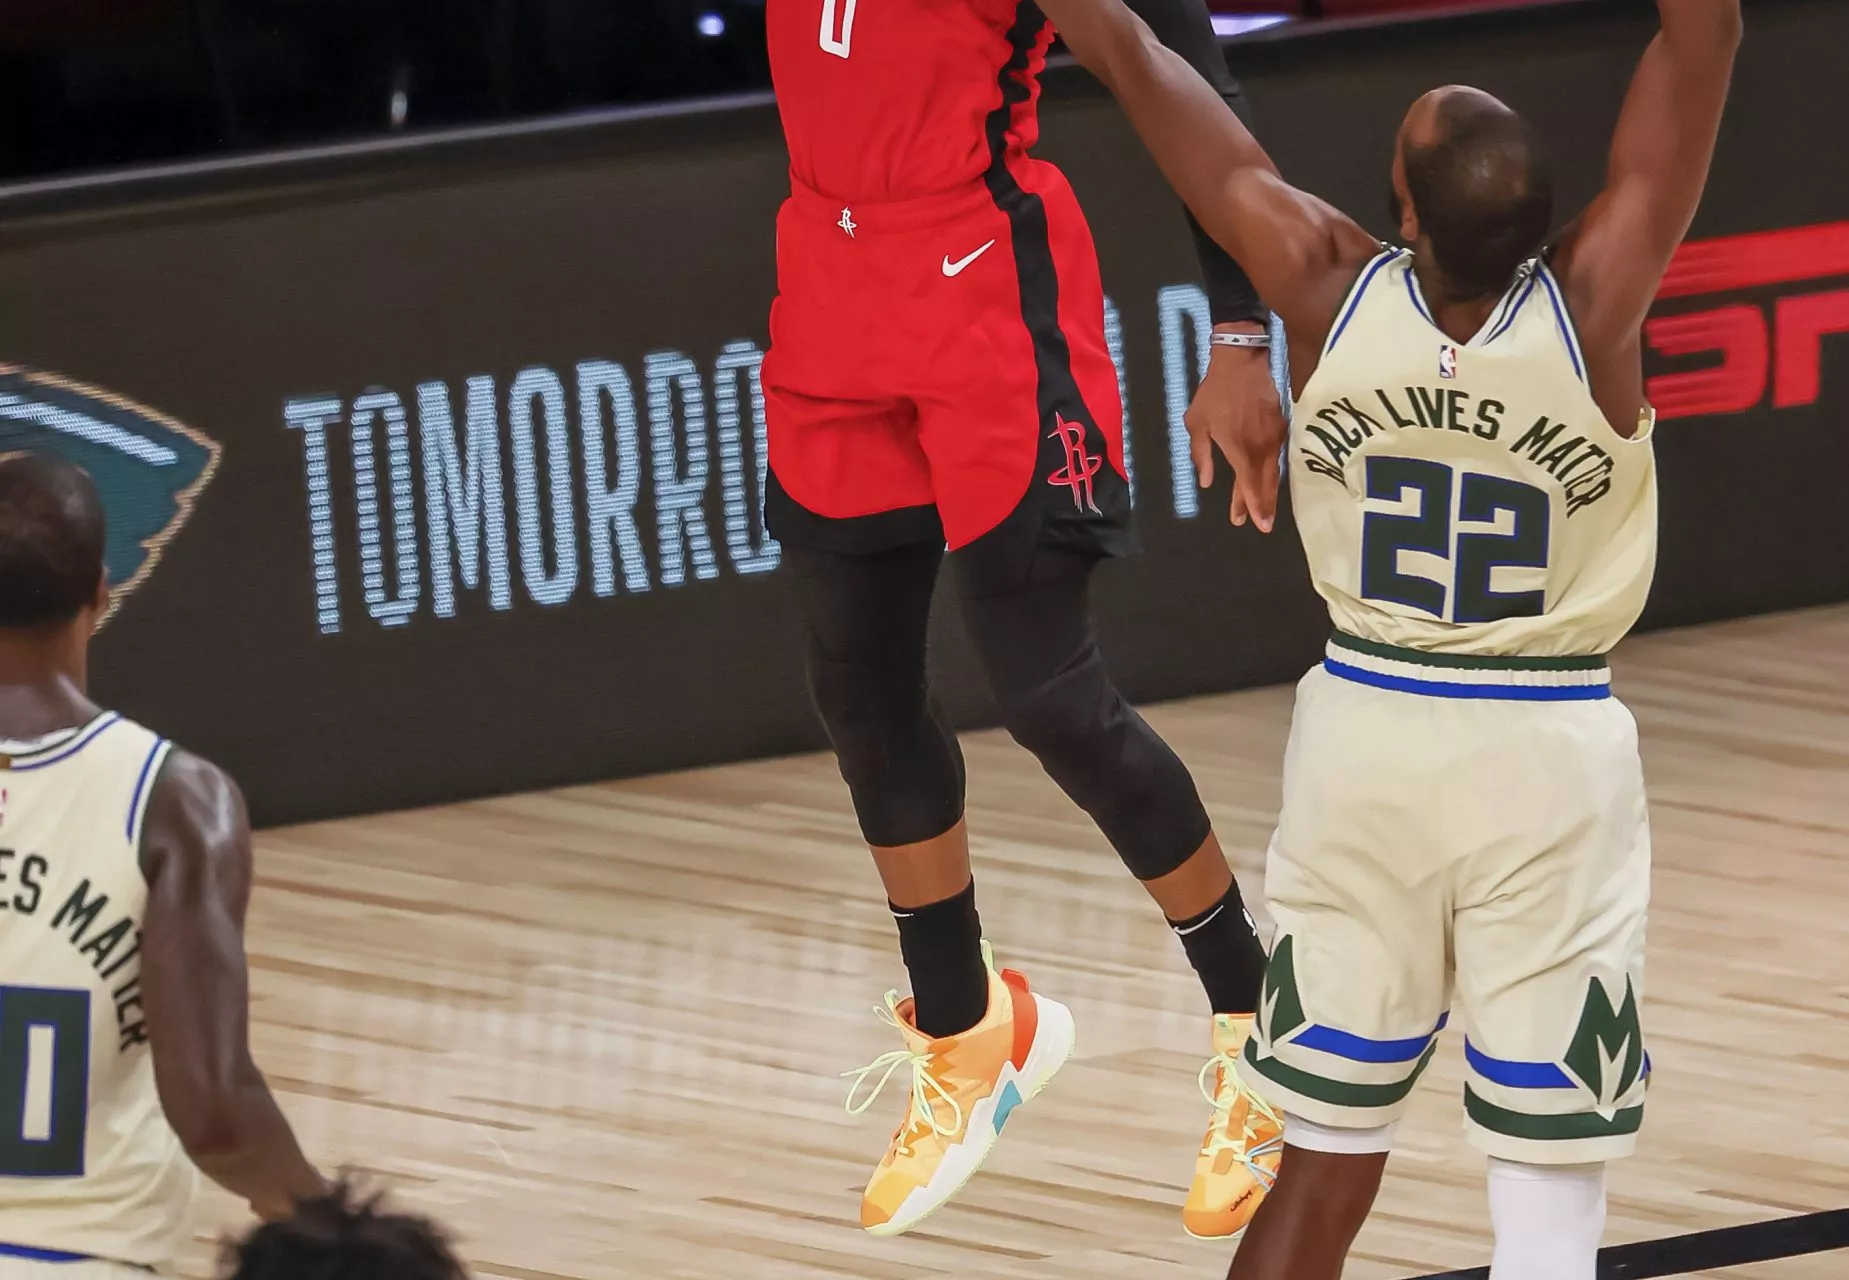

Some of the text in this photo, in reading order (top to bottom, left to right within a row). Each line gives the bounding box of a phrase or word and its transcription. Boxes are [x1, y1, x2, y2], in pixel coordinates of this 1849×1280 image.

[283, 339, 784, 635] TOMORRO
[1299, 386, 1615, 520] BLACK LIVES MATTER
[1360, 455, 1551, 624] 22
[0, 985, 91, 1177] 0
